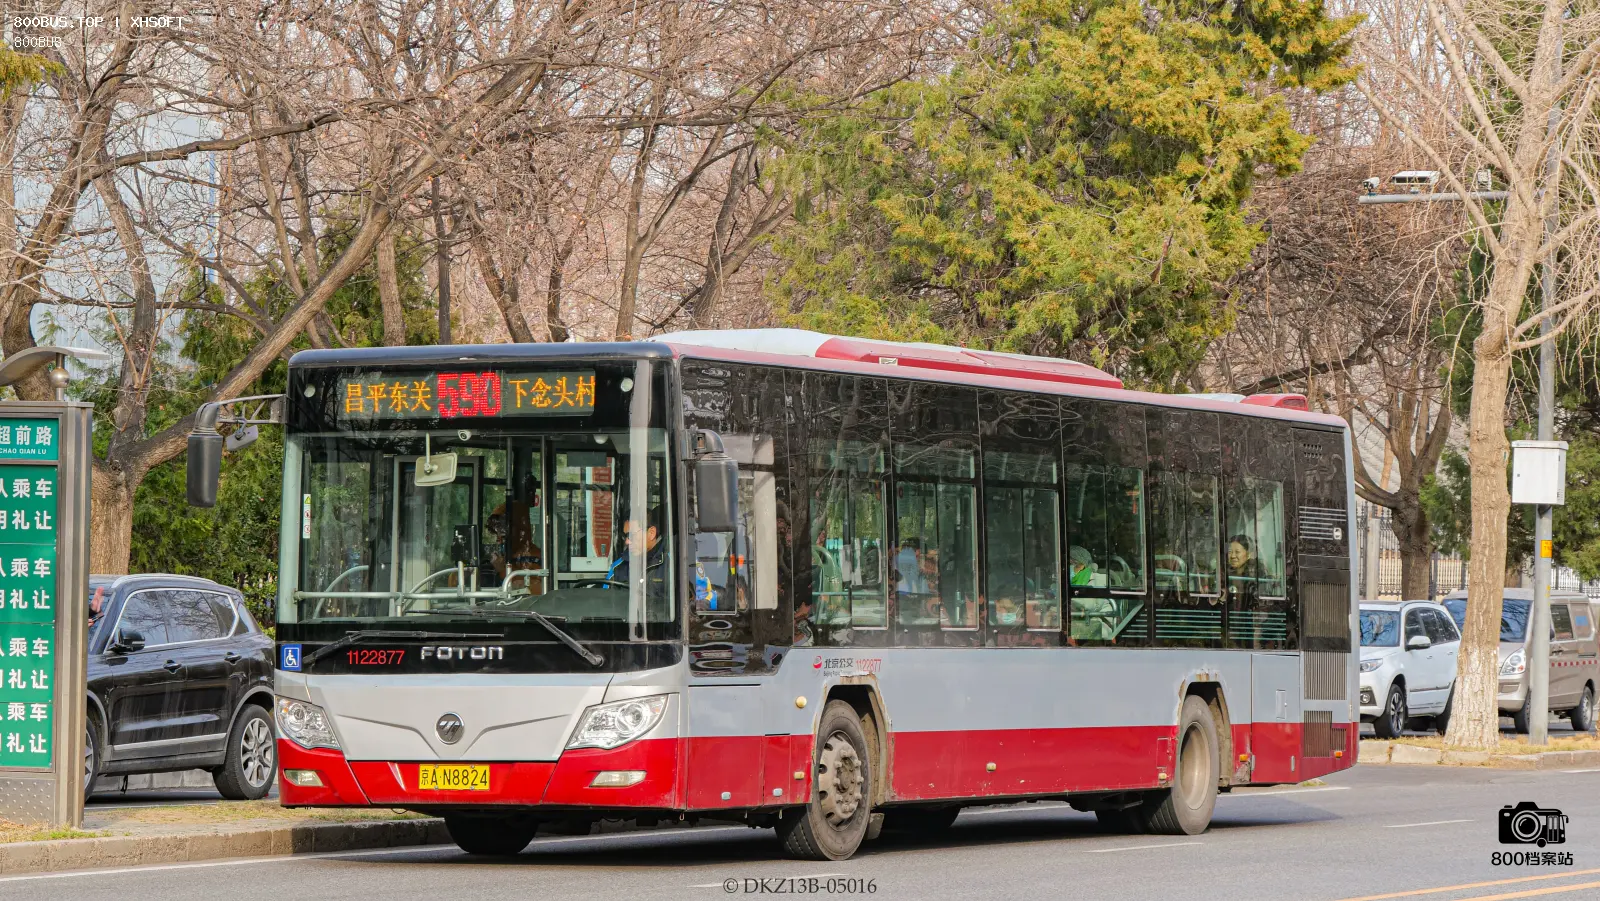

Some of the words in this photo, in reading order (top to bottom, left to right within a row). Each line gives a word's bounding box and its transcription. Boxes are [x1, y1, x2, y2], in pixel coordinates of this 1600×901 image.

[345, 380, 432, 413] 昌平东关
[437, 372, 501, 418] 590
[509, 375, 596, 408] 下念头村
[0, 589, 50, 610] 礼让
[0, 637, 49, 658] 乘车
[346, 650, 405, 665] 1122877
[420, 646, 503, 660] FOTON
[823, 657, 854, 669] 北京公交
[0, 668, 49, 689] 礼让
[0, 702, 48, 722] 乘车
[0, 732, 47, 754] 礼让
